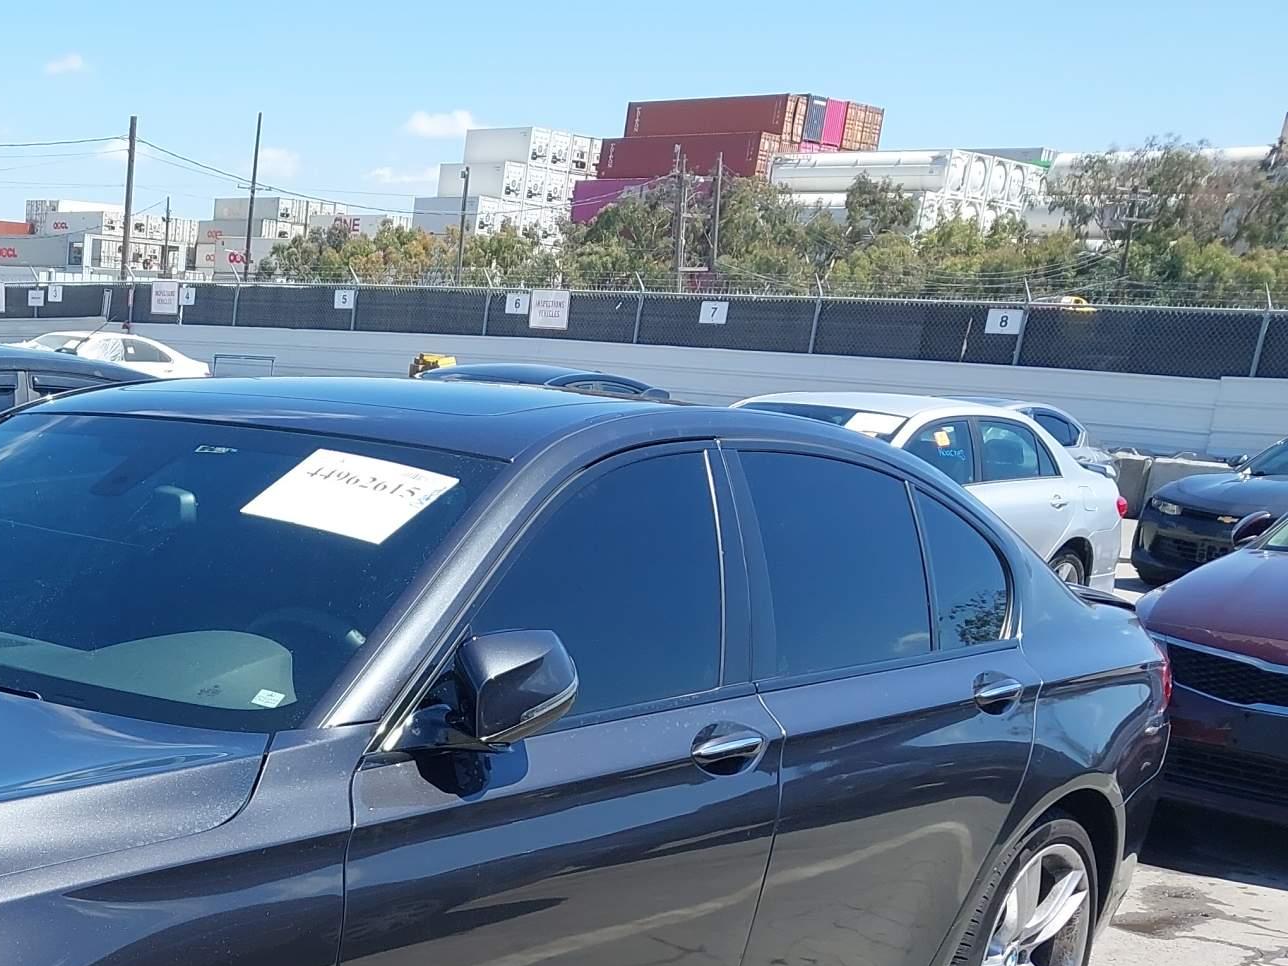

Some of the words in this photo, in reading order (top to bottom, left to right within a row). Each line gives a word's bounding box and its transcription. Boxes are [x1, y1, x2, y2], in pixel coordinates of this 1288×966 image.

[341, 294, 348, 305] 5
[514, 298, 521, 309] 6
[710, 306, 718, 318] 7
[999, 315, 1009, 328] 8
